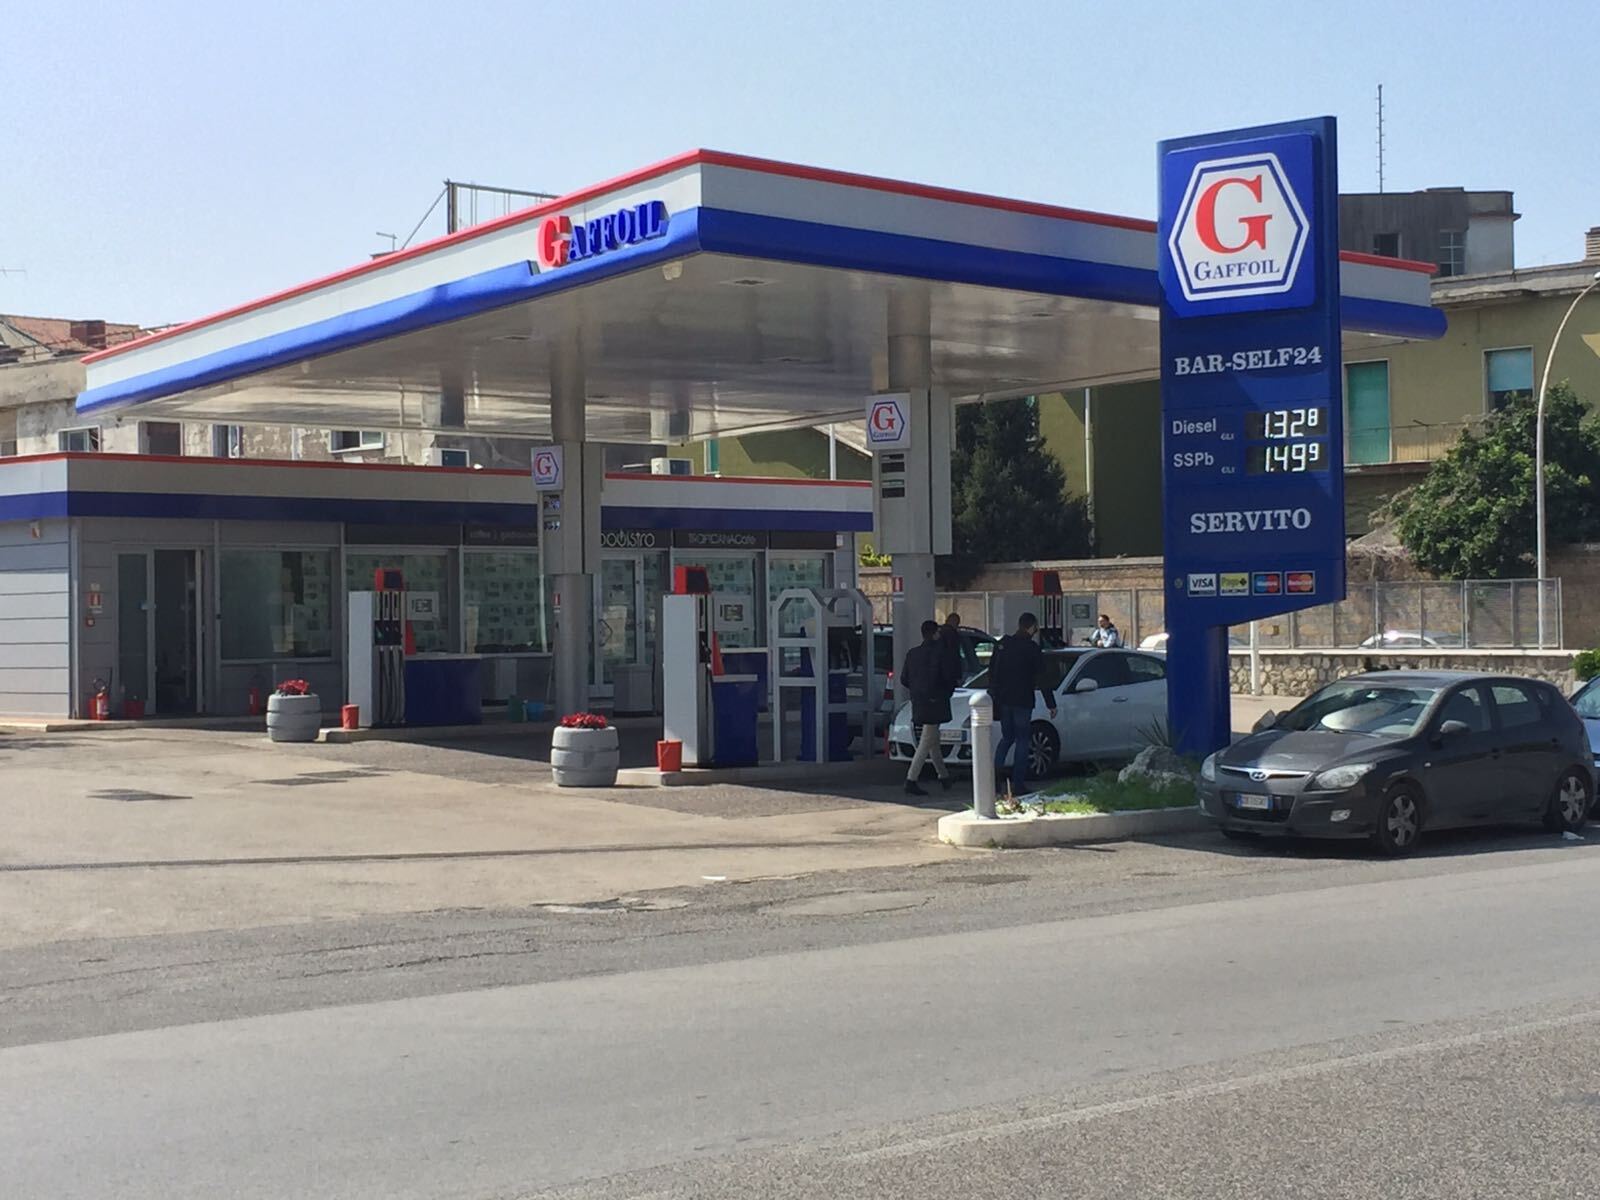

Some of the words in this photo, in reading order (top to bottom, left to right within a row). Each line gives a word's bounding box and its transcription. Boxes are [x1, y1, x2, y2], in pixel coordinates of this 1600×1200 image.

[1195, 174, 1273, 254] G
[537, 200, 669, 268] GAFFOIL
[1194, 259, 1280, 281] GAFFOIL
[1174, 346, 1322, 376] BAR-SELF24
[873, 406, 895, 430] G
[1172, 417, 1217, 435] Diesel
[1173, 452, 1215, 468] SSPb
[1190, 508, 1312, 534] SERVITO
[1192, 577, 1214, 588] VISA
